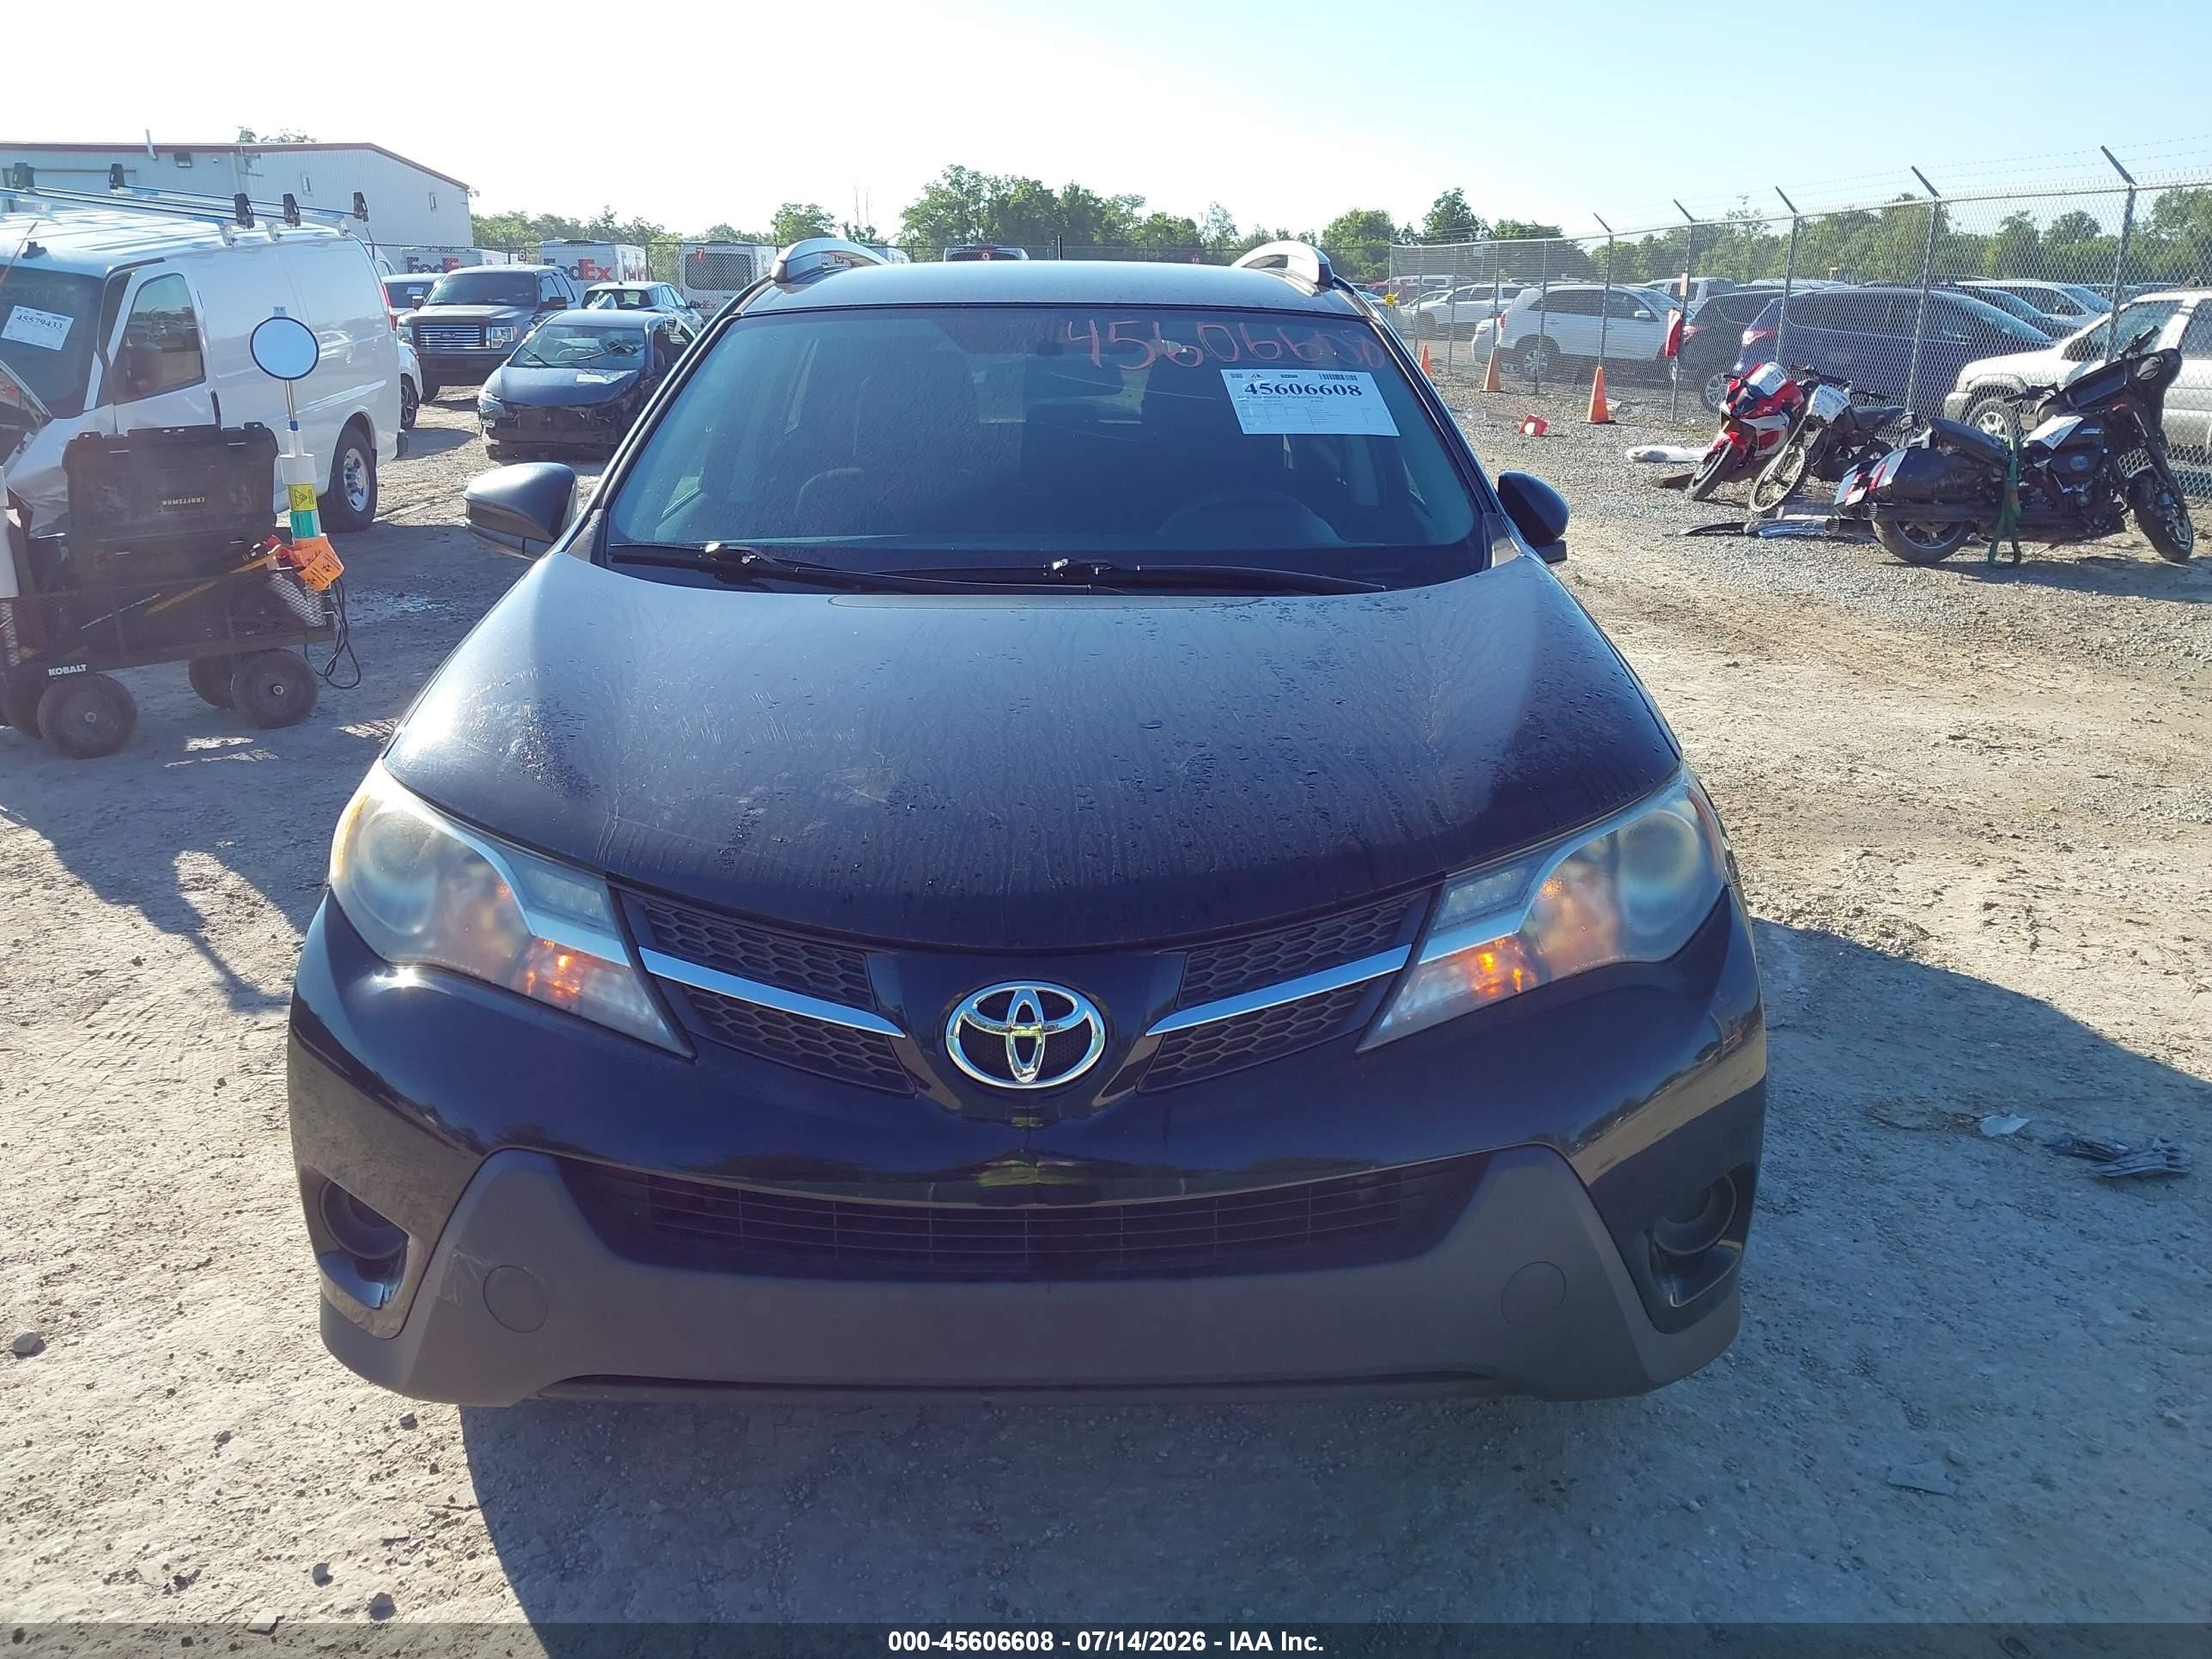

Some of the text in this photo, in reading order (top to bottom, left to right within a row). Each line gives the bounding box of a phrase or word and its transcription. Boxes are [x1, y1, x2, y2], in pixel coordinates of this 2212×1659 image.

[519, 249, 526, 260] 6
[696, 248, 704, 260] 7
[405, 257, 460, 273] FedE
[15, 314, 63, 330] 45579433
[1244, 383, 1363, 397] 45606608
[48, 664, 87, 677] KOBALT
